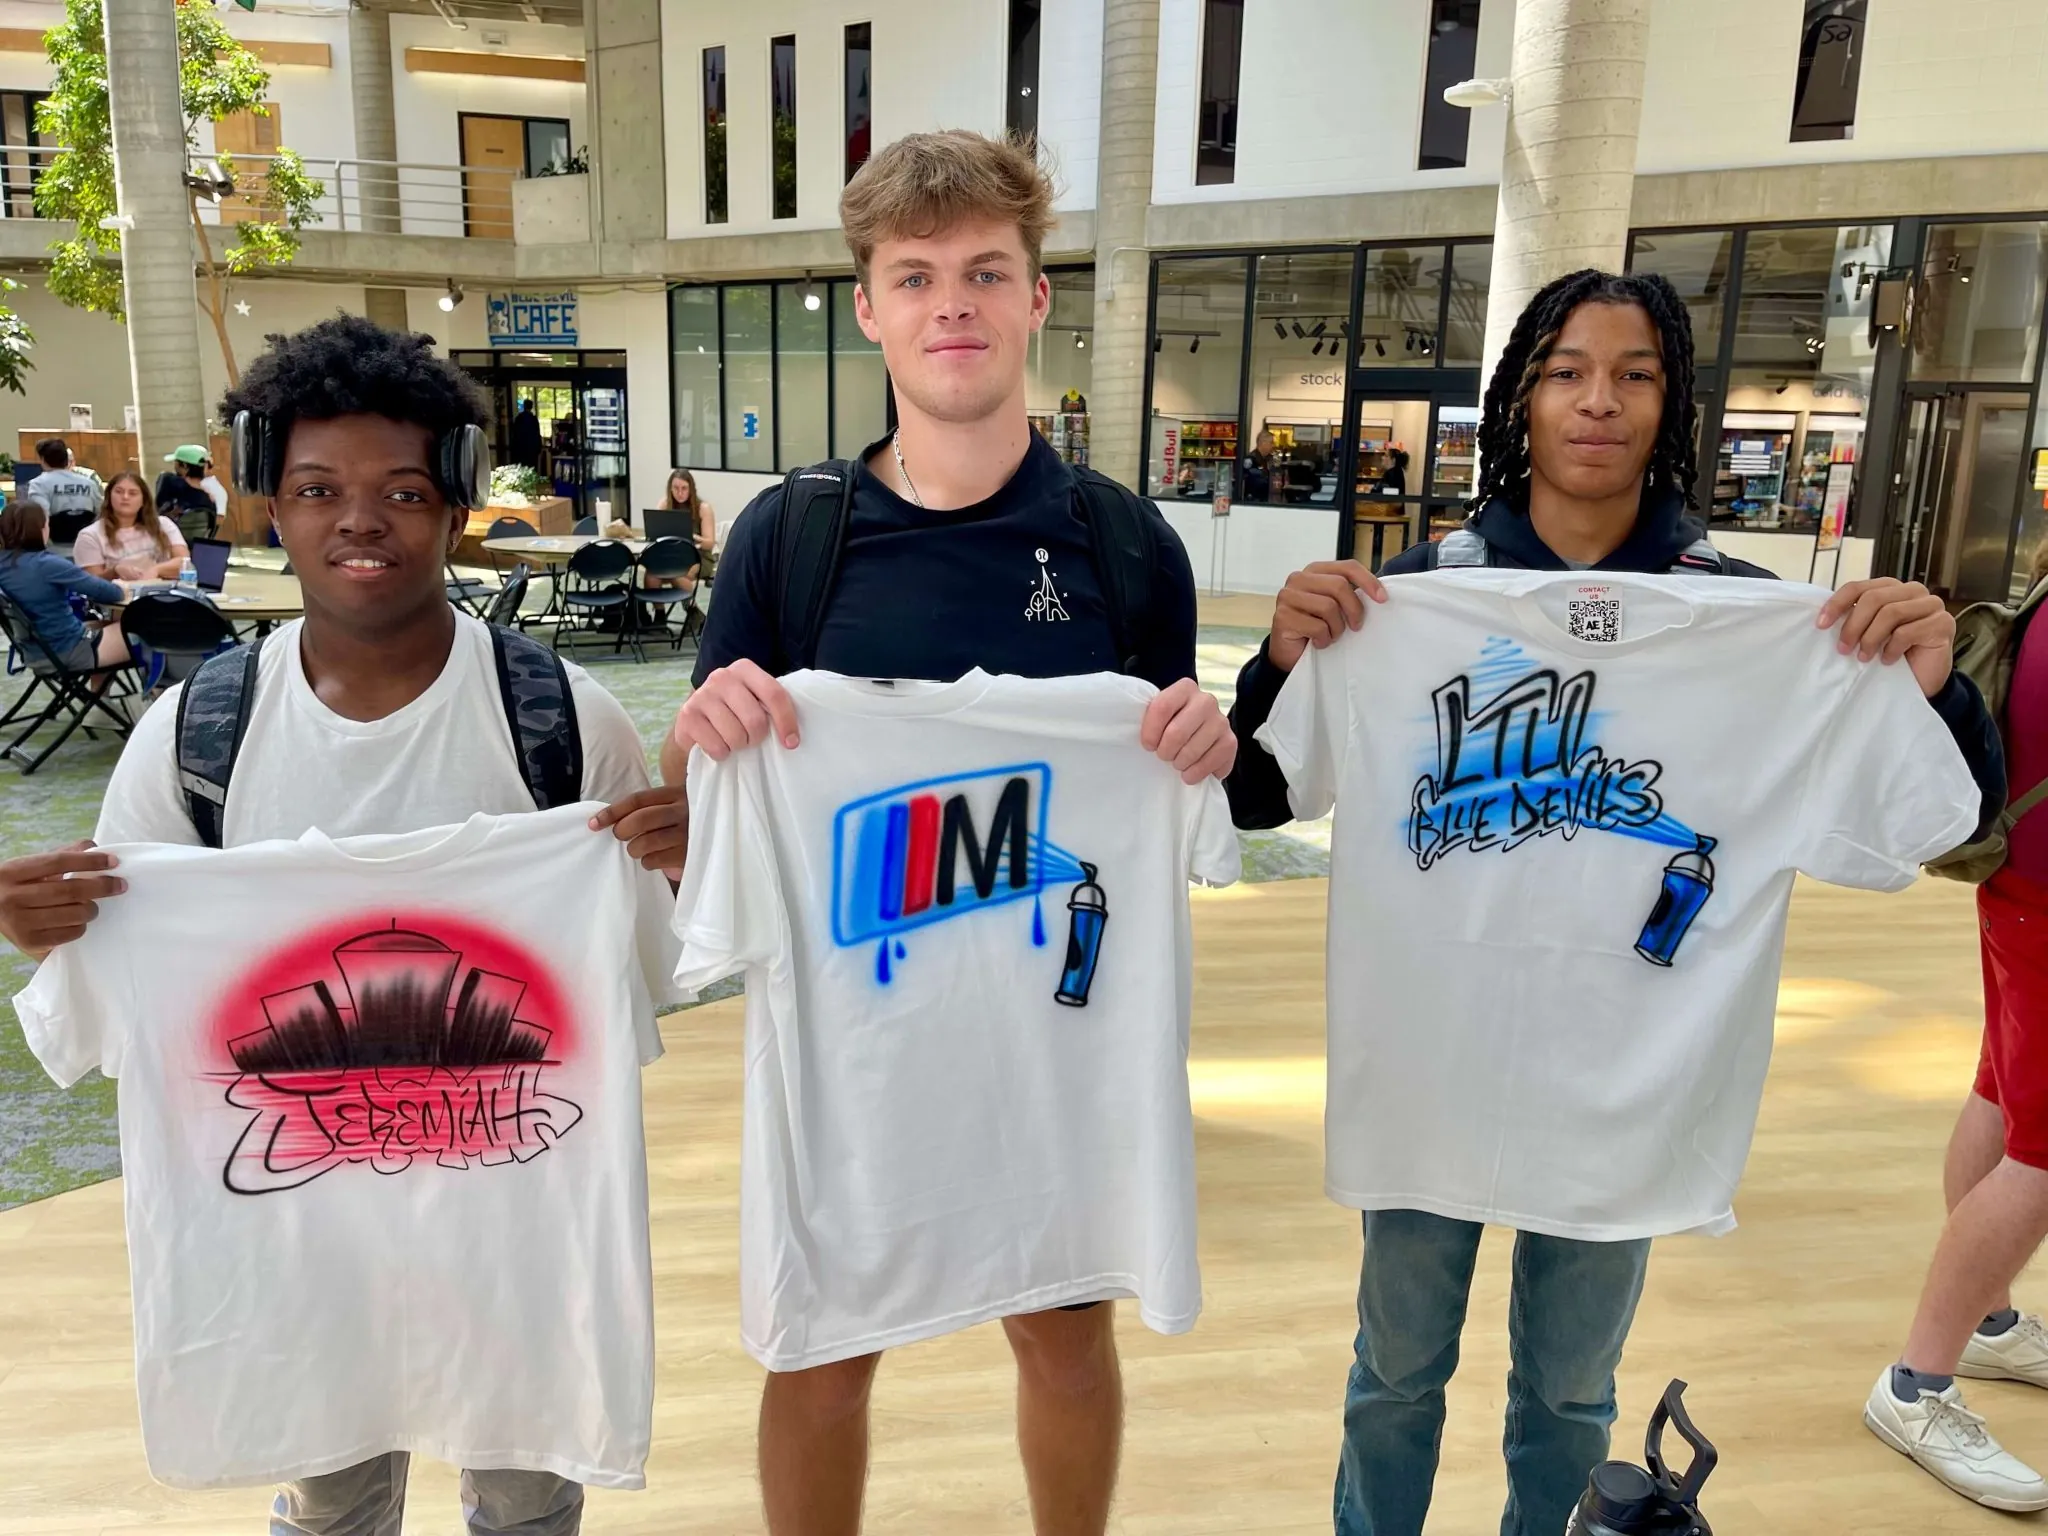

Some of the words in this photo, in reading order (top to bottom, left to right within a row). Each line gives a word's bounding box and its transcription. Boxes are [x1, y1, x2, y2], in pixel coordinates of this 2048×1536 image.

[513, 304, 577, 333] CAFE
[1300, 372, 1342, 386] stock
[1164, 430, 1177, 456] Bull
[1162, 459, 1175, 485] Red
[1578, 586, 1611, 594] CONTACT
[1585, 620, 1601, 631] AE
[1434, 671, 1596, 797] LTU
[1410, 776, 1500, 860] BLUE
[1510, 756, 1661, 836] DEVILS
[936, 777, 1030, 907] M
